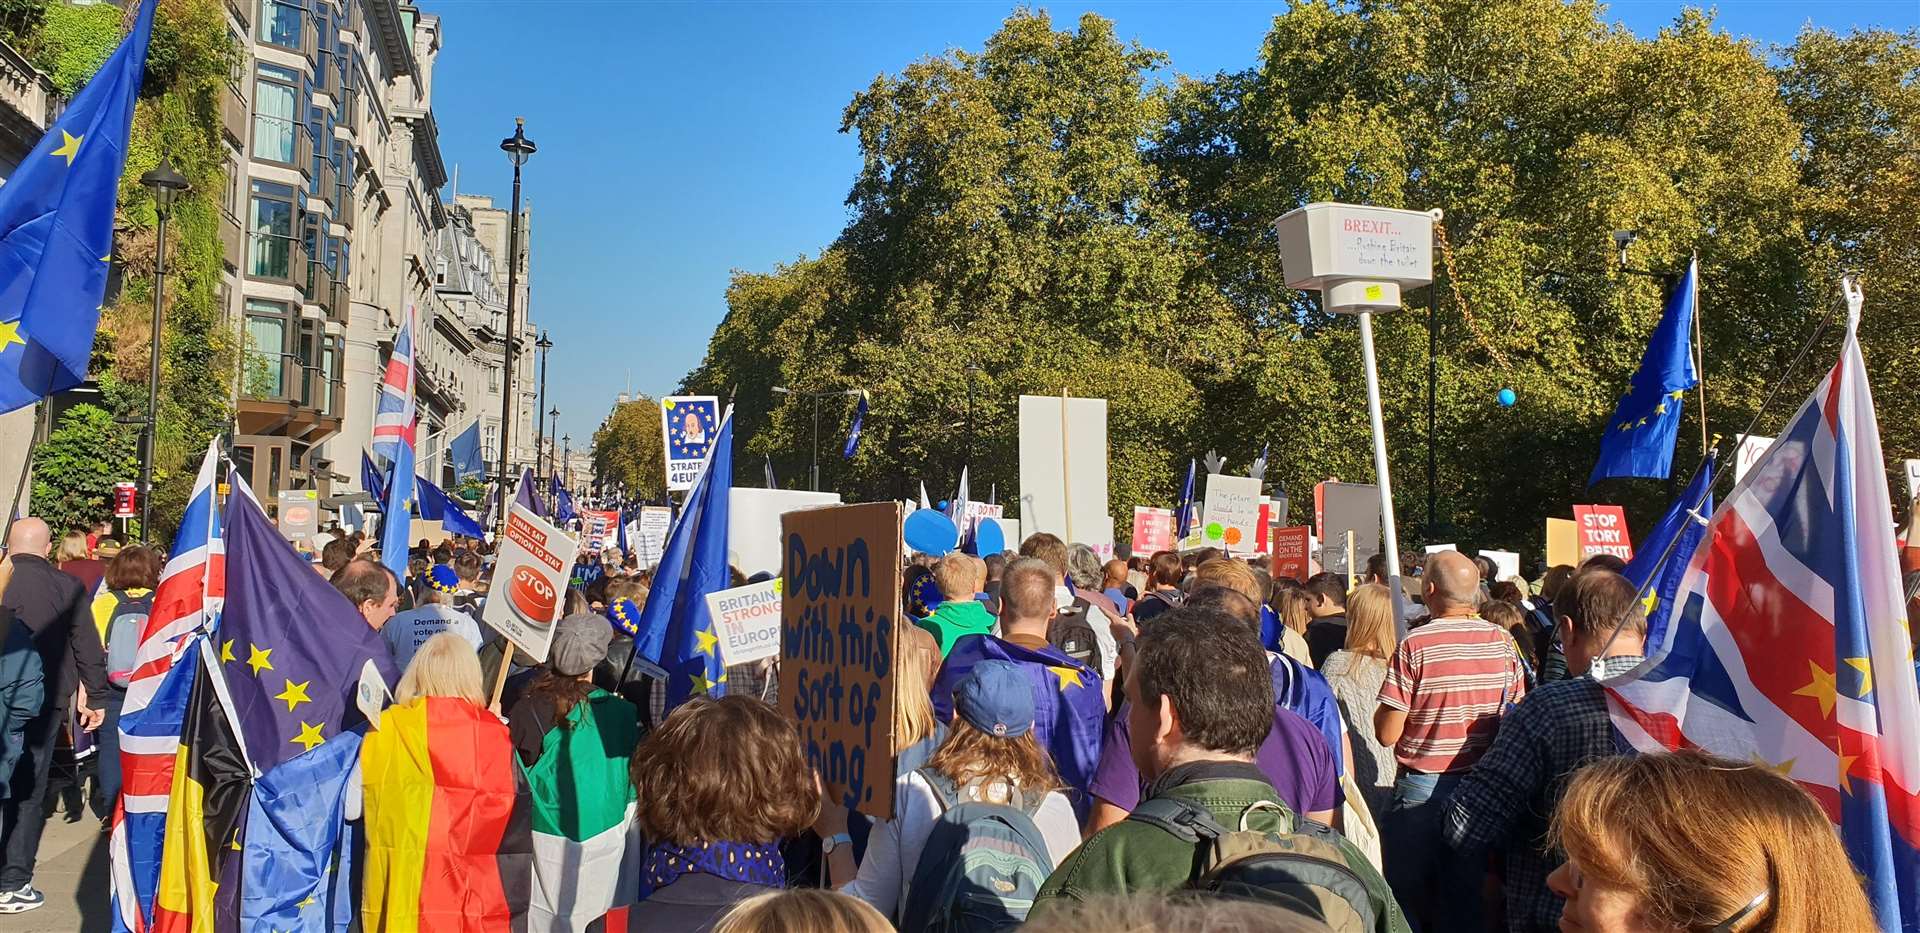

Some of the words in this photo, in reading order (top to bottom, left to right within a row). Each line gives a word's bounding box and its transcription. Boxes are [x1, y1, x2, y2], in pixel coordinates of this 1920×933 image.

[513, 516, 531, 535] FINAL
[530, 529, 545, 543] SAY
[1583, 514, 1617, 527] STOP
[1585, 530, 1620, 542] TORY
[510, 530, 535, 552] OPTION
[534, 546, 544, 557] TO
[543, 553, 561, 570] STAY
[788, 533, 870, 602] Down
[517, 569, 554, 600] STOP
[719, 590, 777, 612] BRITAIN
[722, 596, 782, 624] STRONG
[414, 628, 433, 636] vote
[726, 622, 744, 636] IN
[728, 625, 780, 648] EUROP
[784, 602, 835, 666] with
[838, 604, 891, 679] this
[849, 680, 881, 749] of
[798, 722, 872, 810] hing.
